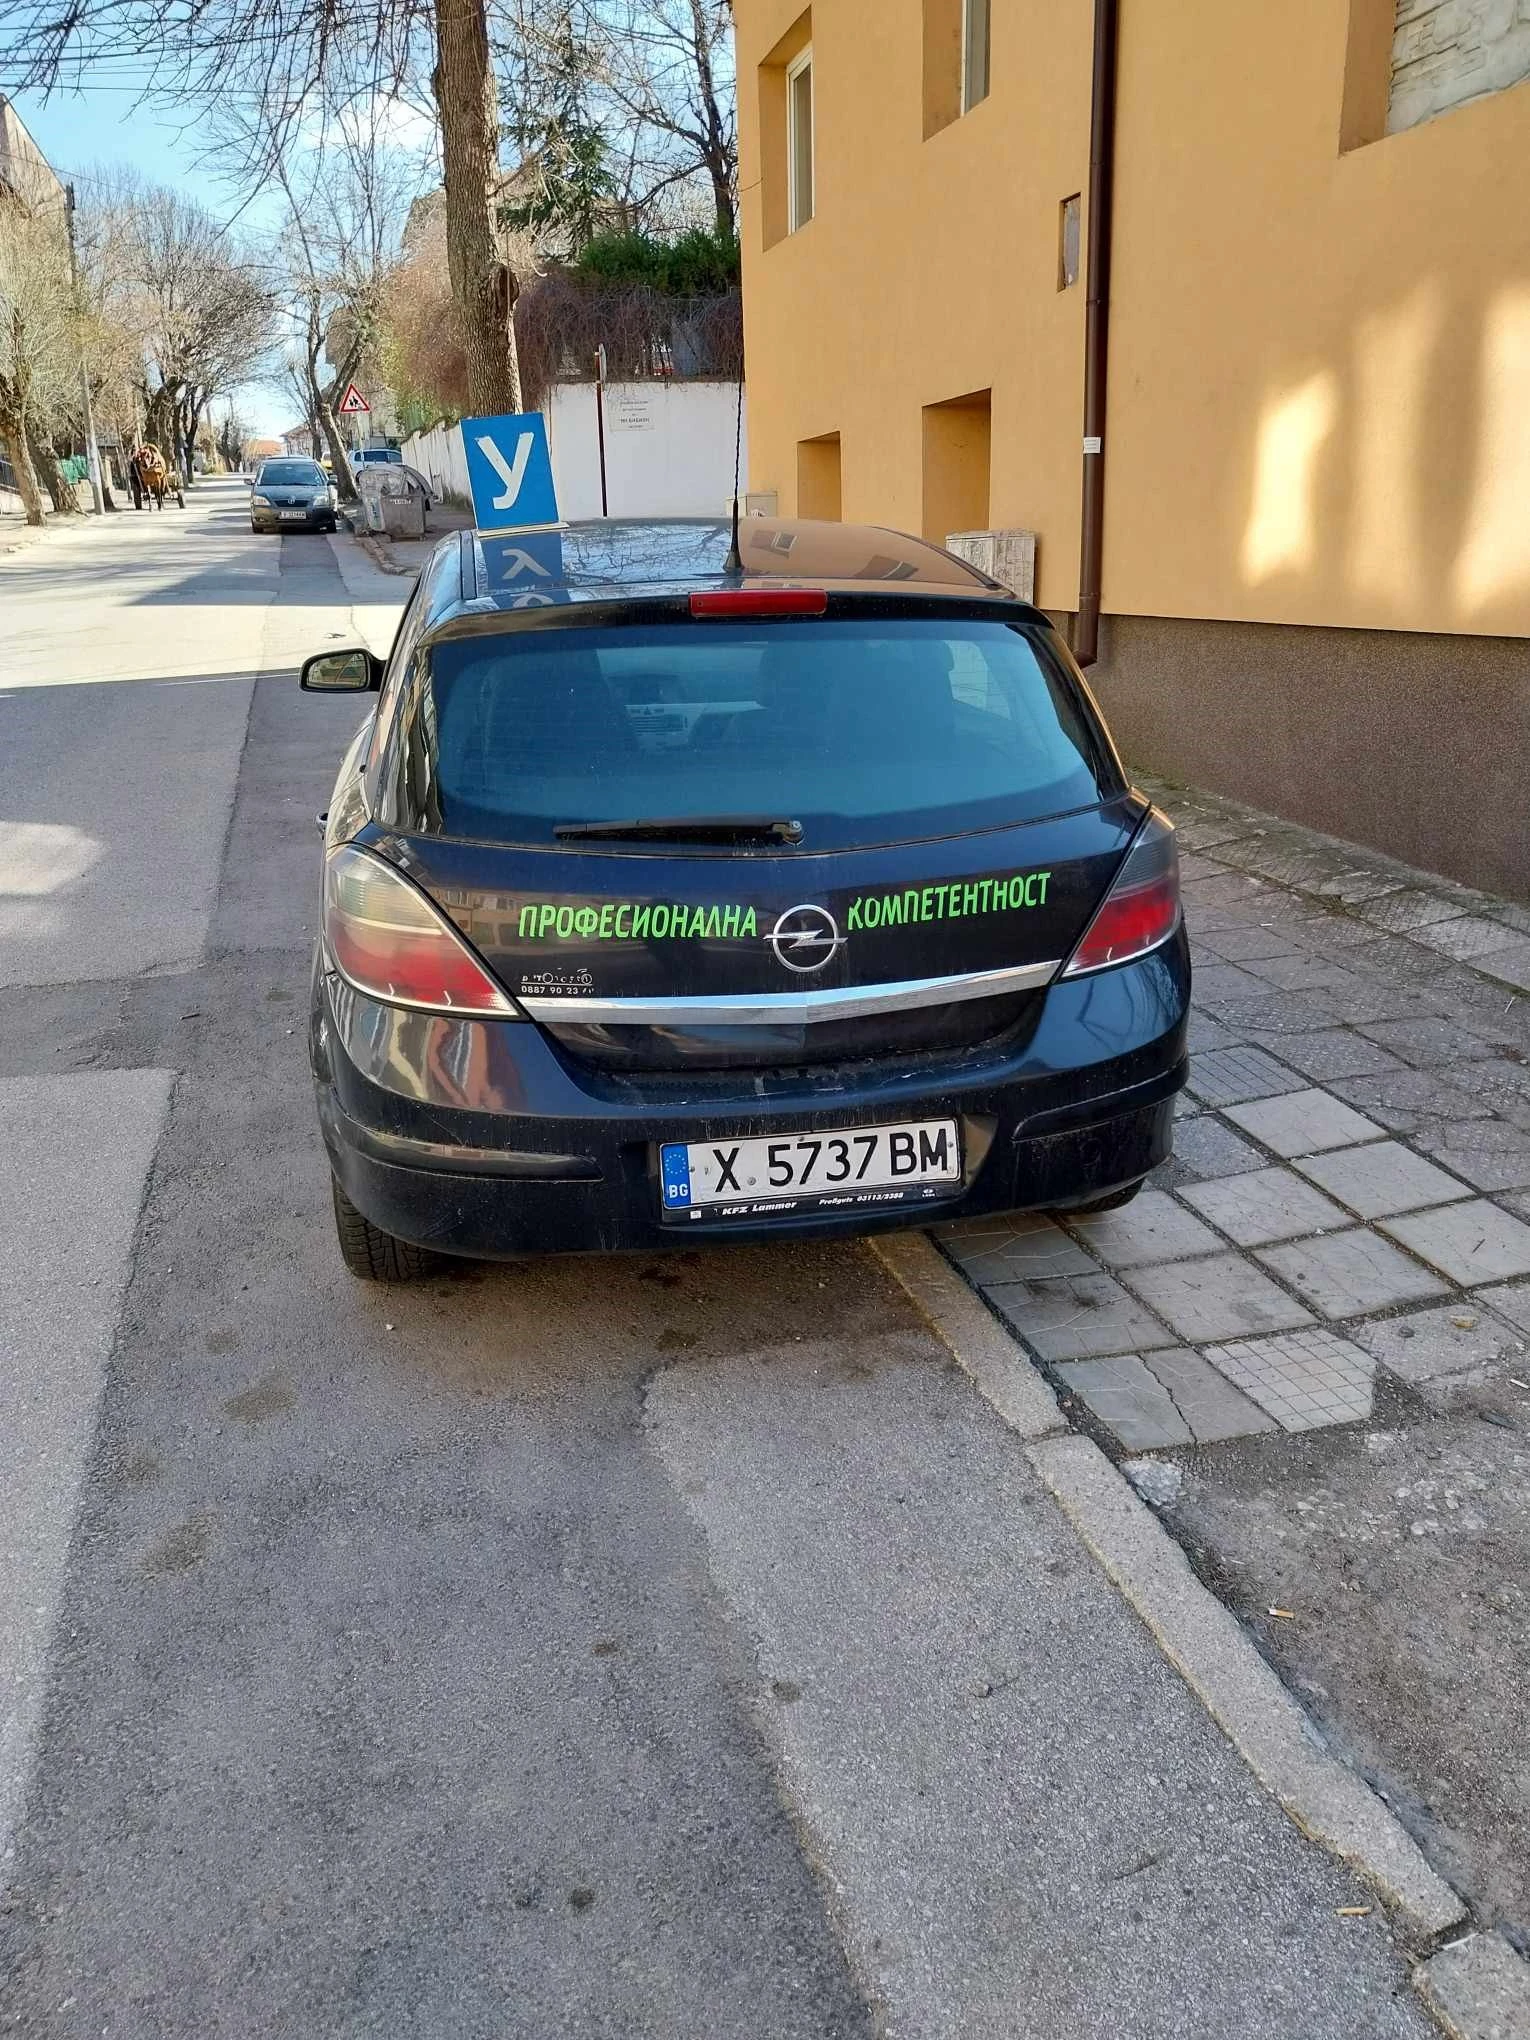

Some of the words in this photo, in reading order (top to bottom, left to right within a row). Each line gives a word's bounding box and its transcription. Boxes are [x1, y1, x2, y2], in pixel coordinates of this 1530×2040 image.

[475, 432, 535, 510] У
[847, 872, 1052, 931] КОМПЕТЕНТНОСТ
[518, 904, 758, 938] ПРОФЕСИОНАЛНА
[521, 985, 546, 994] 0887
[550, 986, 563, 994] 90
[566, 987, 579, 995] 23
[767, 1135, 879, 1188] 5737
[668, 1182, 689, 1199] BG
[722, 1206, 749, 1216] KFZ
[752, 1202, 797, 1213] Lammer
